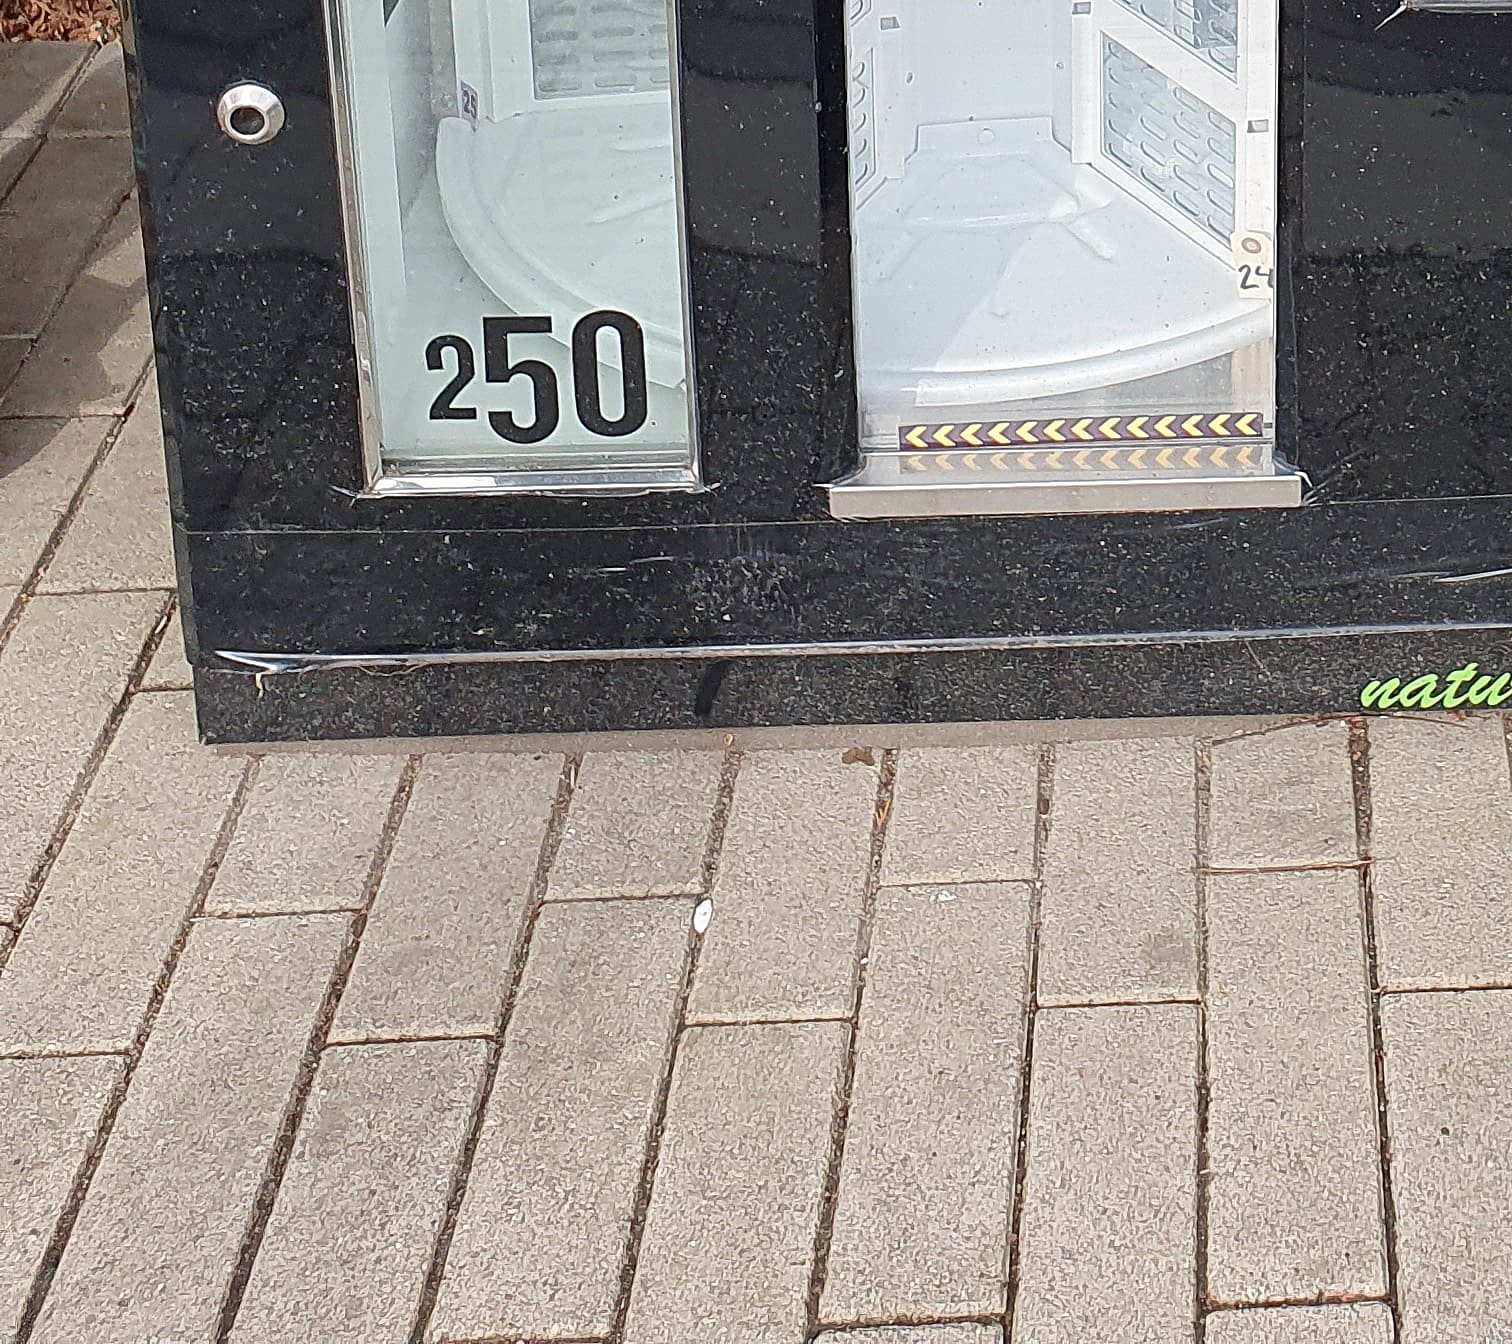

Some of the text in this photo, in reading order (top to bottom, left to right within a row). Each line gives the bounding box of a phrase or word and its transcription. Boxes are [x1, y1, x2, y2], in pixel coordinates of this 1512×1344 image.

[462, 89, 477, 119] 25
[1238, 264, 1275, 290] 24
[425, 309, 649, 445] 250
